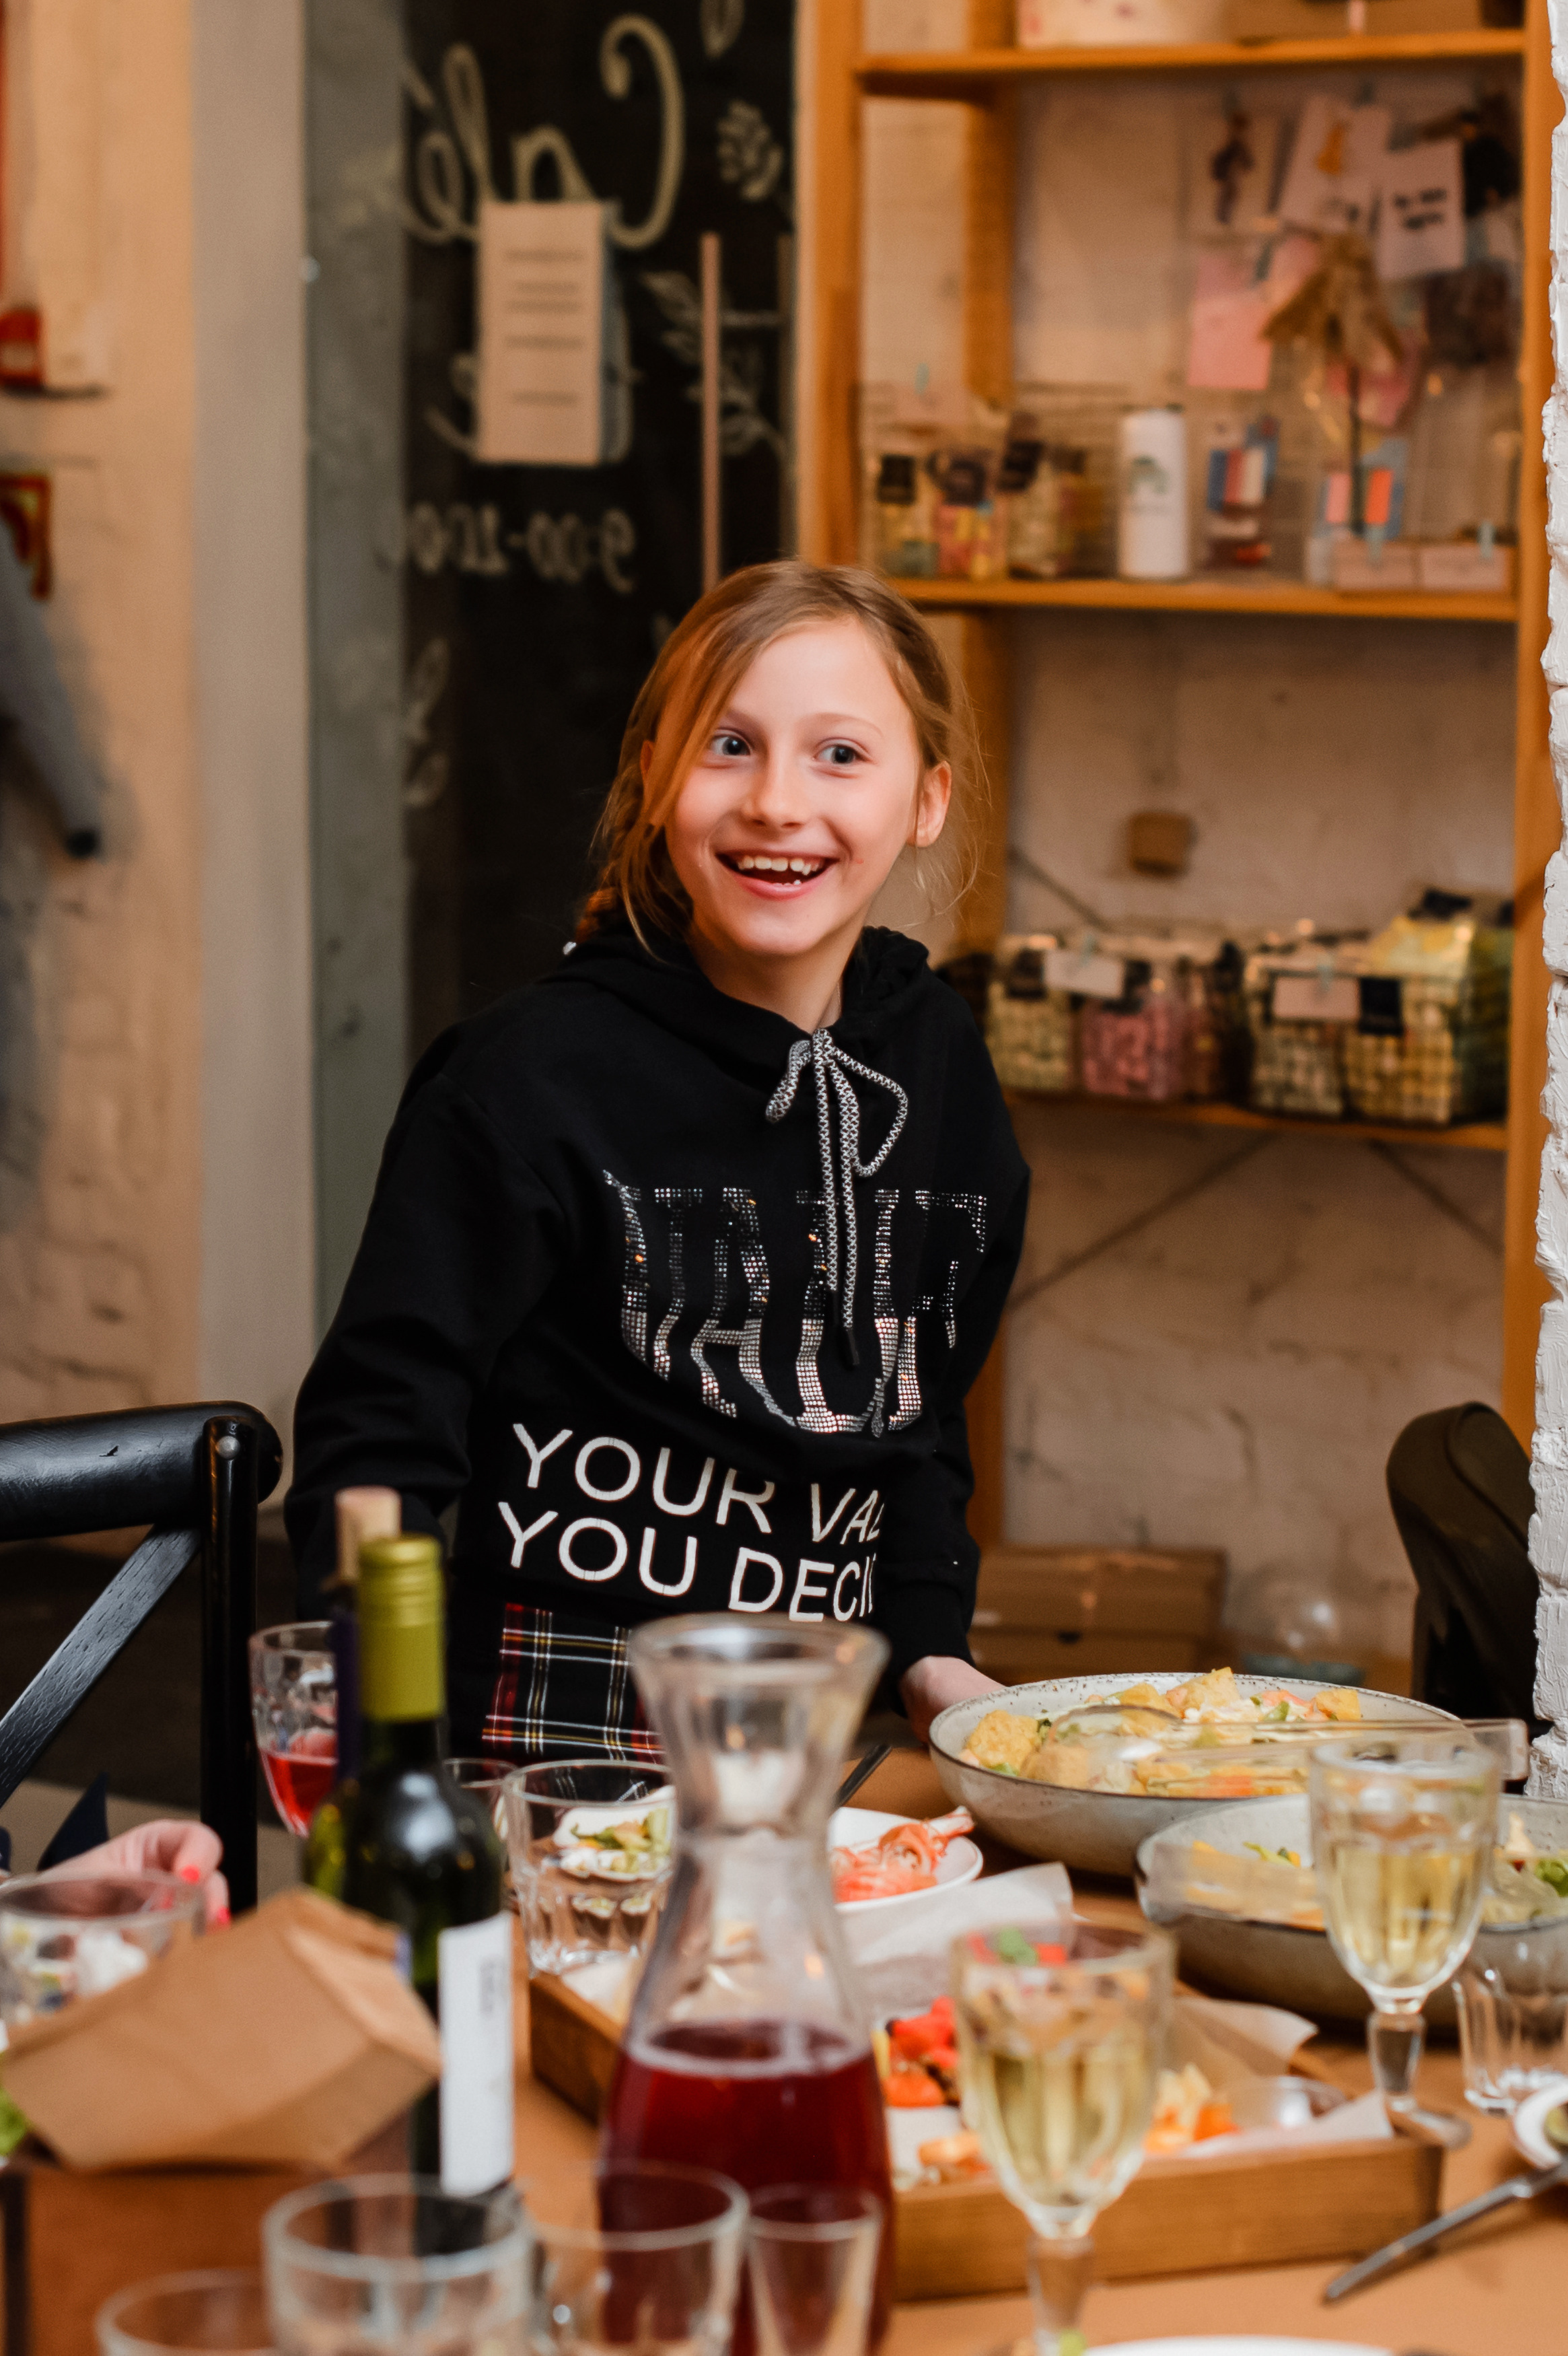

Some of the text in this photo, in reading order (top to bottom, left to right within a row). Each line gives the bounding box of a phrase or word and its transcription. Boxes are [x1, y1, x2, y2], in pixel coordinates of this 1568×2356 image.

[513, 1422, 776, 1533] YOUR
[498, 1501, 877, 1622] YOU DECI
